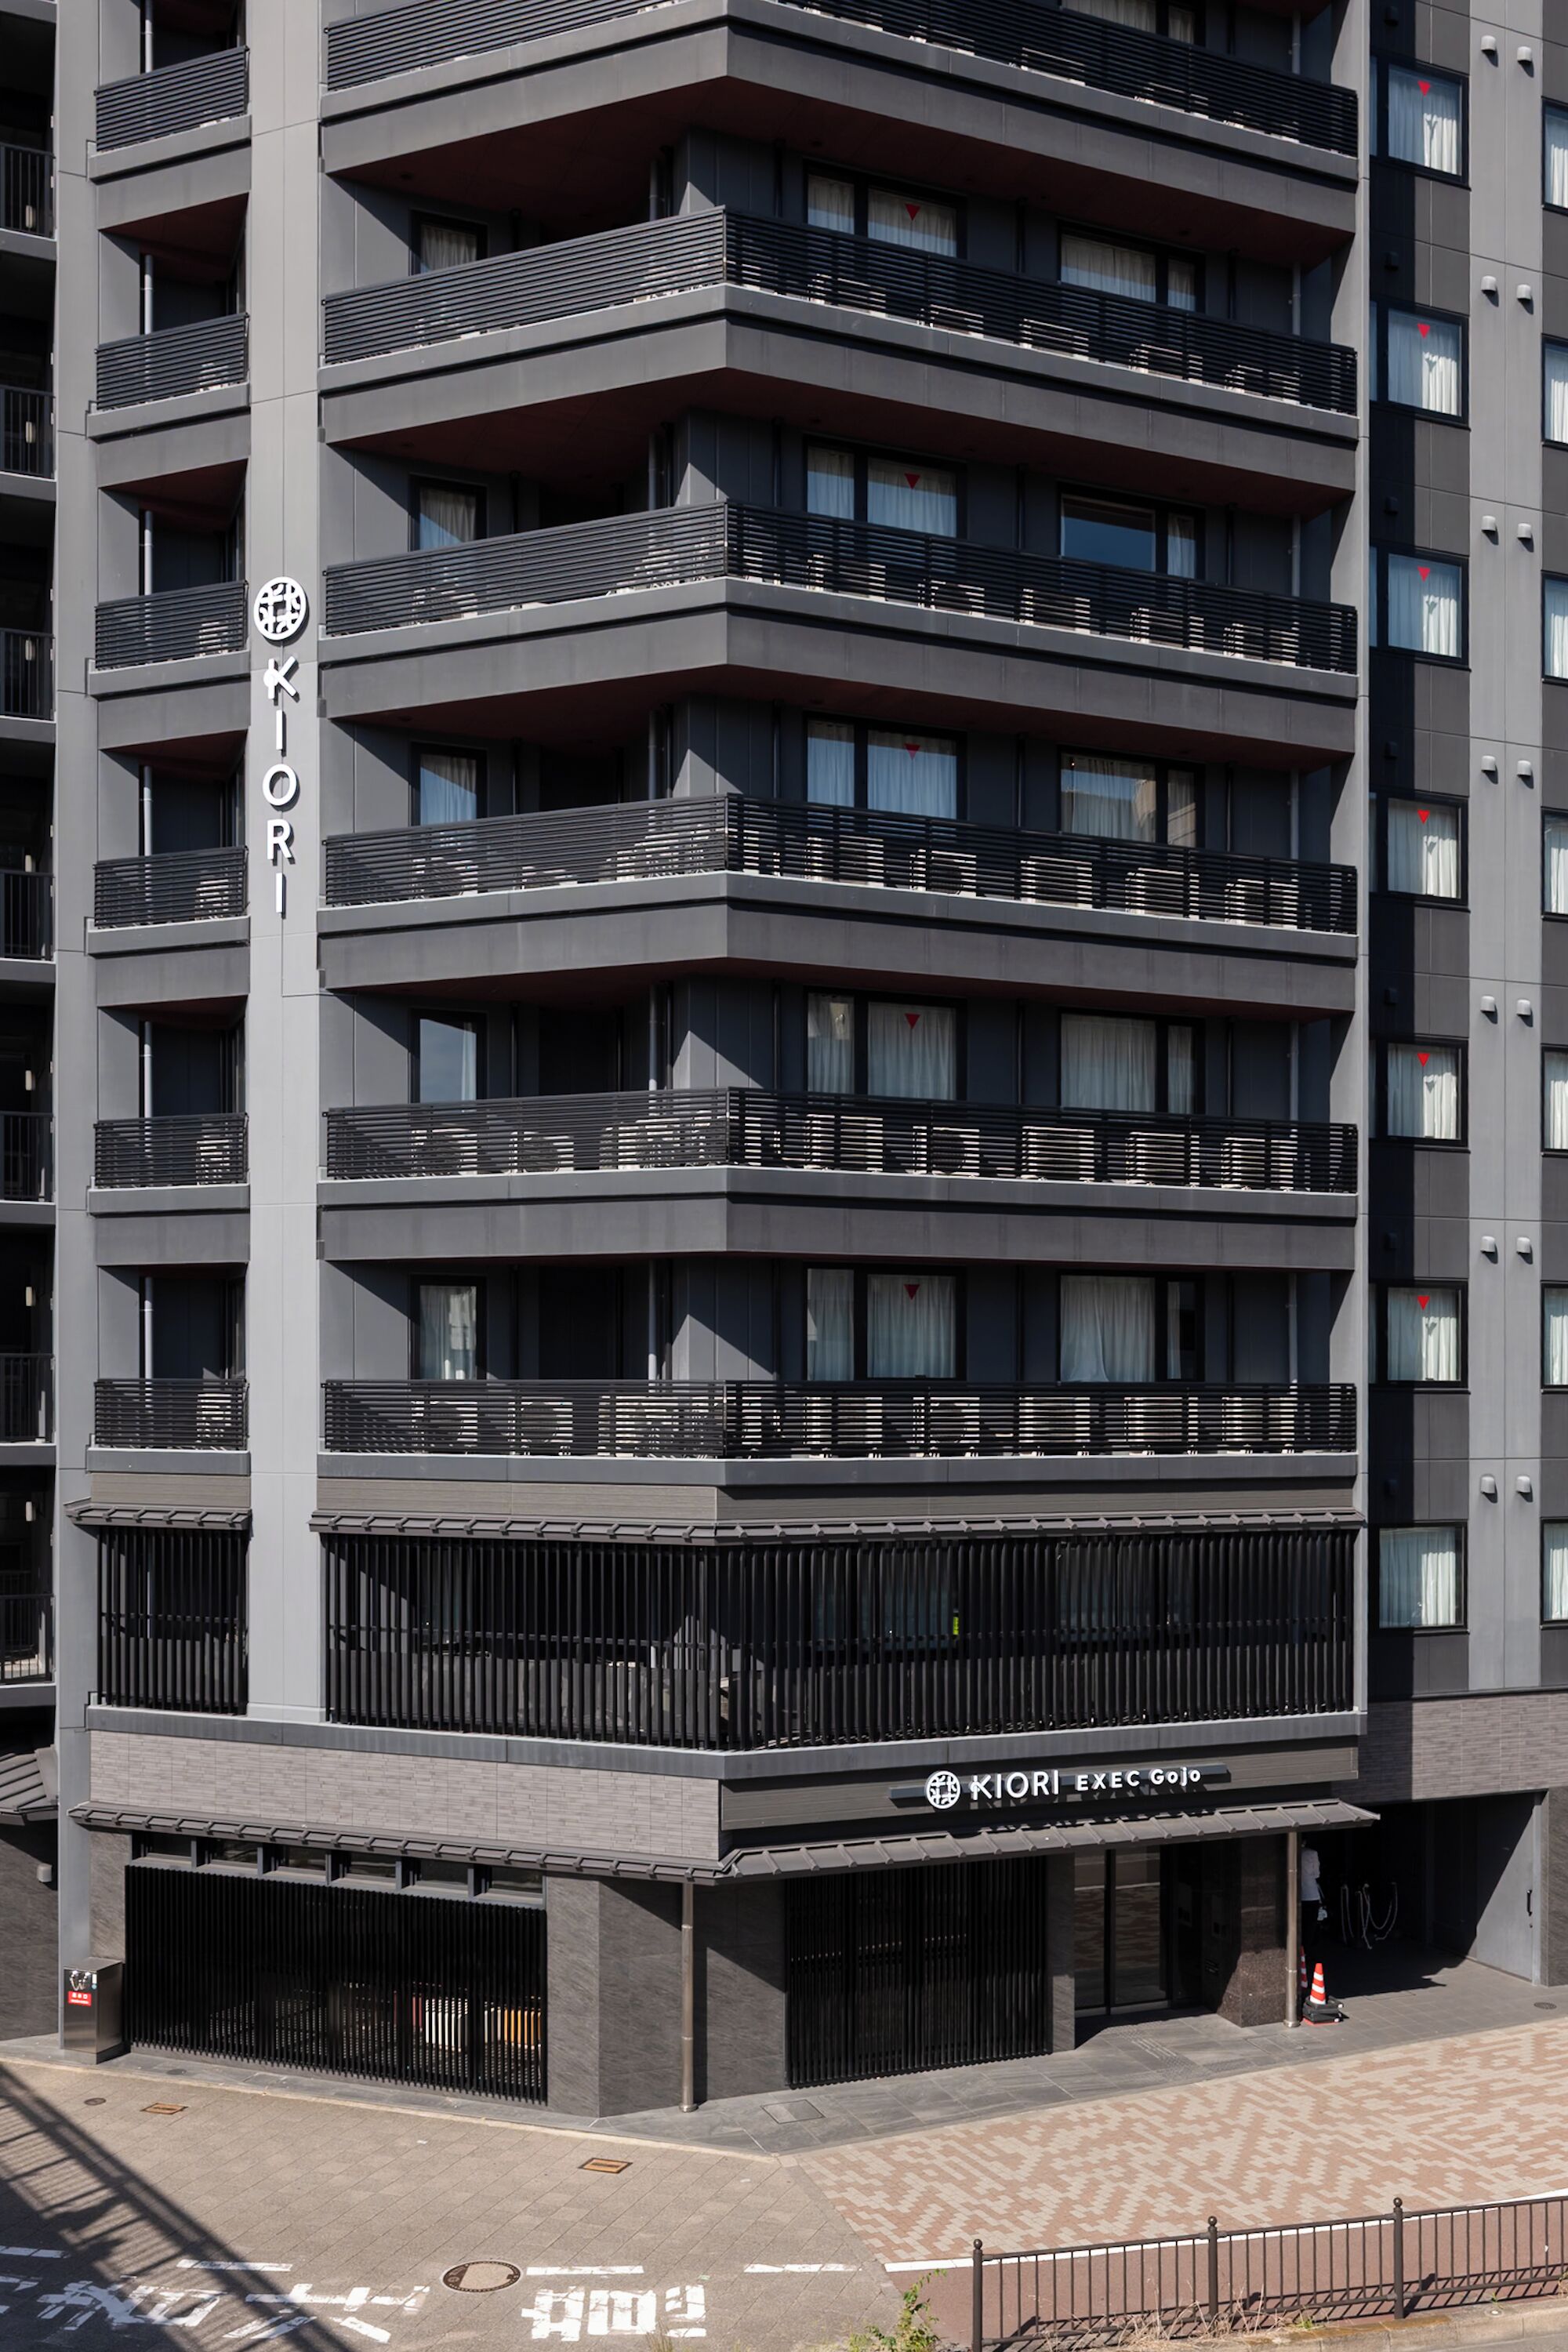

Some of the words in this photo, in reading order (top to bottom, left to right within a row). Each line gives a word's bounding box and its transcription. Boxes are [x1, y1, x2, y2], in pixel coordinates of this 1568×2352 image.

[263, 656, 298, 914] KIORI
[970, 1769, 1058, 1801] KIORI
[1076, 1770, 1141, 1791] EXEC
[1149, 1766, 1201, 1787] Gojo
